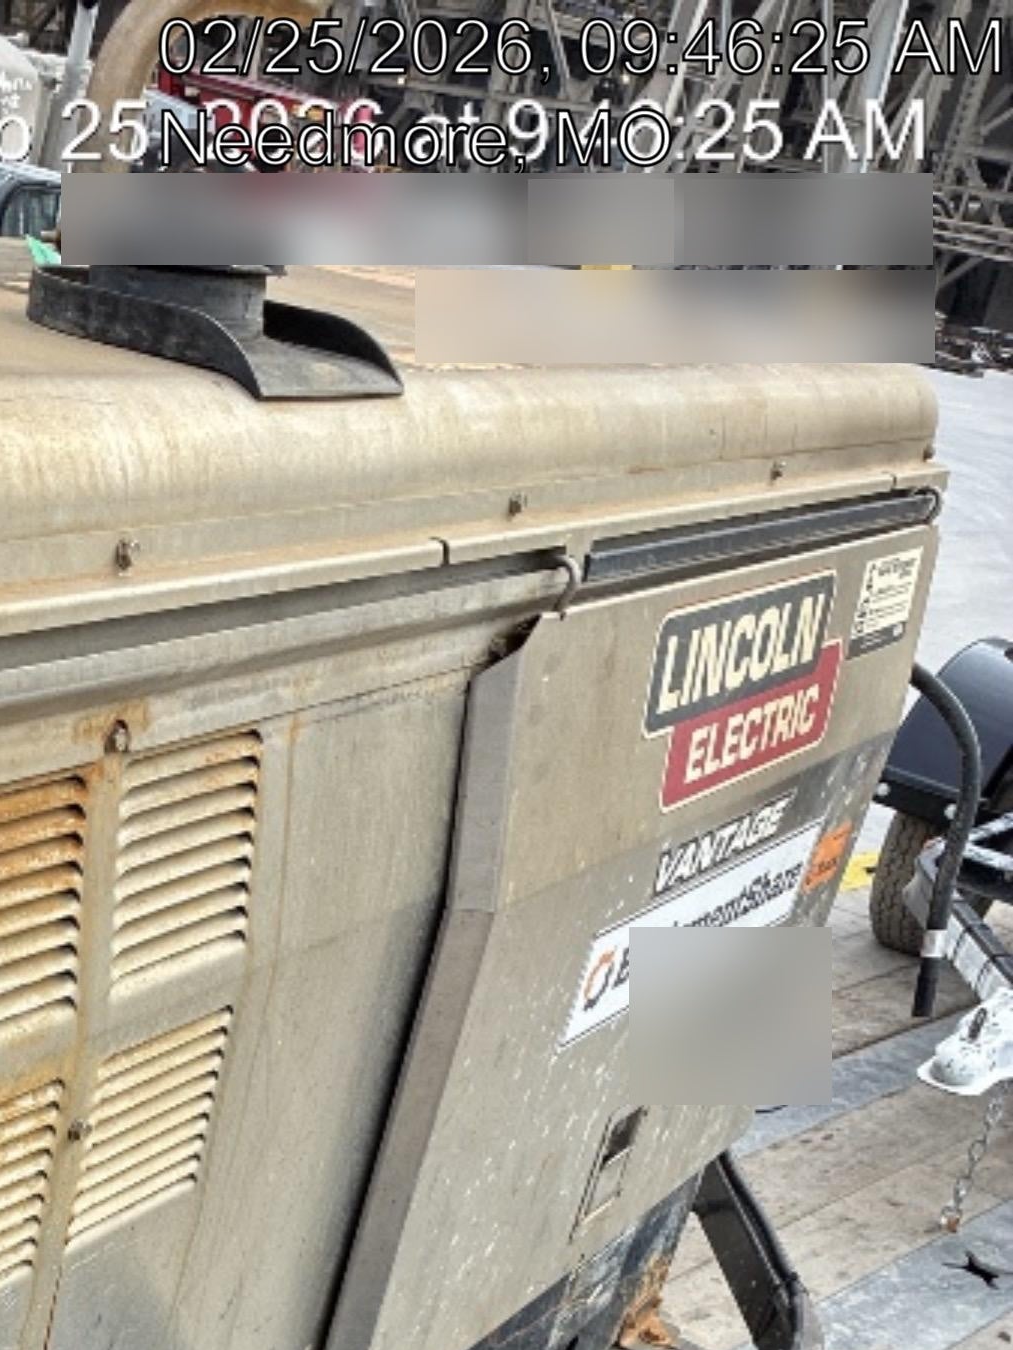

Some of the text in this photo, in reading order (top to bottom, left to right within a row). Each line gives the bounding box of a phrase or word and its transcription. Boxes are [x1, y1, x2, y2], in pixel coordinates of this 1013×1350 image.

[655, 592, 826, 714] LINCOLN
[684, 684, 820, 784] ELECTRIC
[653, 794, 794, 893] VANTAGE
